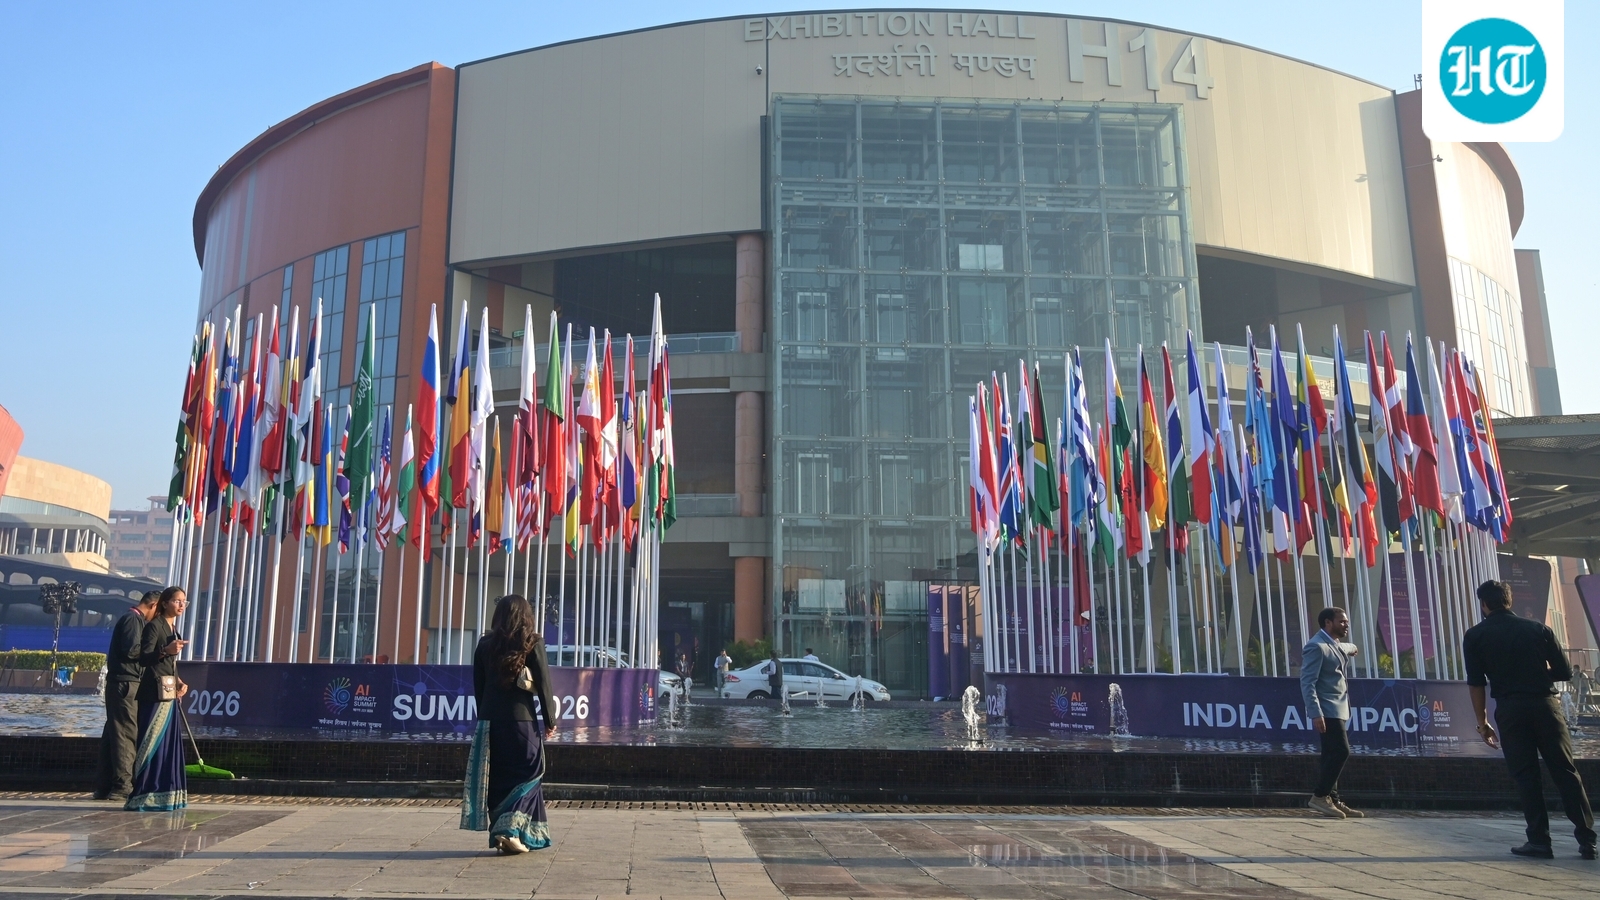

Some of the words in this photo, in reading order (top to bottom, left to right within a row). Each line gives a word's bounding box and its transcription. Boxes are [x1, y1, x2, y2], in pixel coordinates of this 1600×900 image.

[744, 13, 935, 42] EXHIBITION
[947, 13, 1036, 40] HALL
[832, 43, 938, 77] प्रदर्शनी
[951, 52, 1037, 80] मण्डप
[1066, 19, 1215, 100] H14
[188, 689, 240, 716] 2026
[355, 684, 370, 696] AI
[1071, 691, 1081, 701] AI
[392, 694, 478, 720] SUM
[1183, 702, 1272, 729] INDIA
[1346, 707, 1419, 733] MPAC
[1433, 700, 1443, 711] AI
